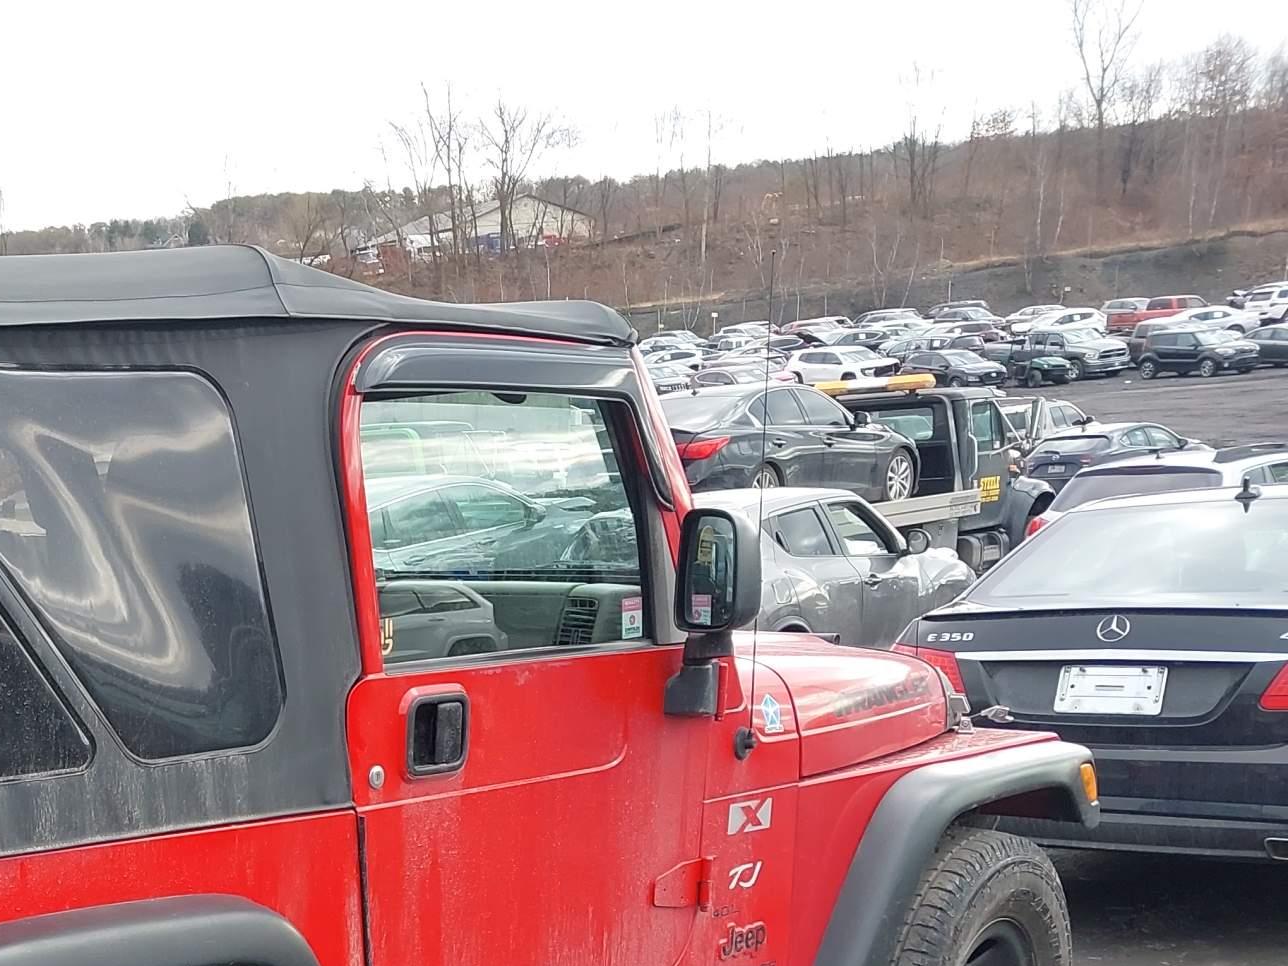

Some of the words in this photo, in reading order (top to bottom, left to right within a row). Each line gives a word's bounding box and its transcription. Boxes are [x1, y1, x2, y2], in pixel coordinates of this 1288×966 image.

[927, 633, 938, 642] E
[939, 632, 975, 642] 350
[731, 797, 770, 834] X
[728, 860, 763, 890] TJ
[718, 922, 768, 960] Jeep
